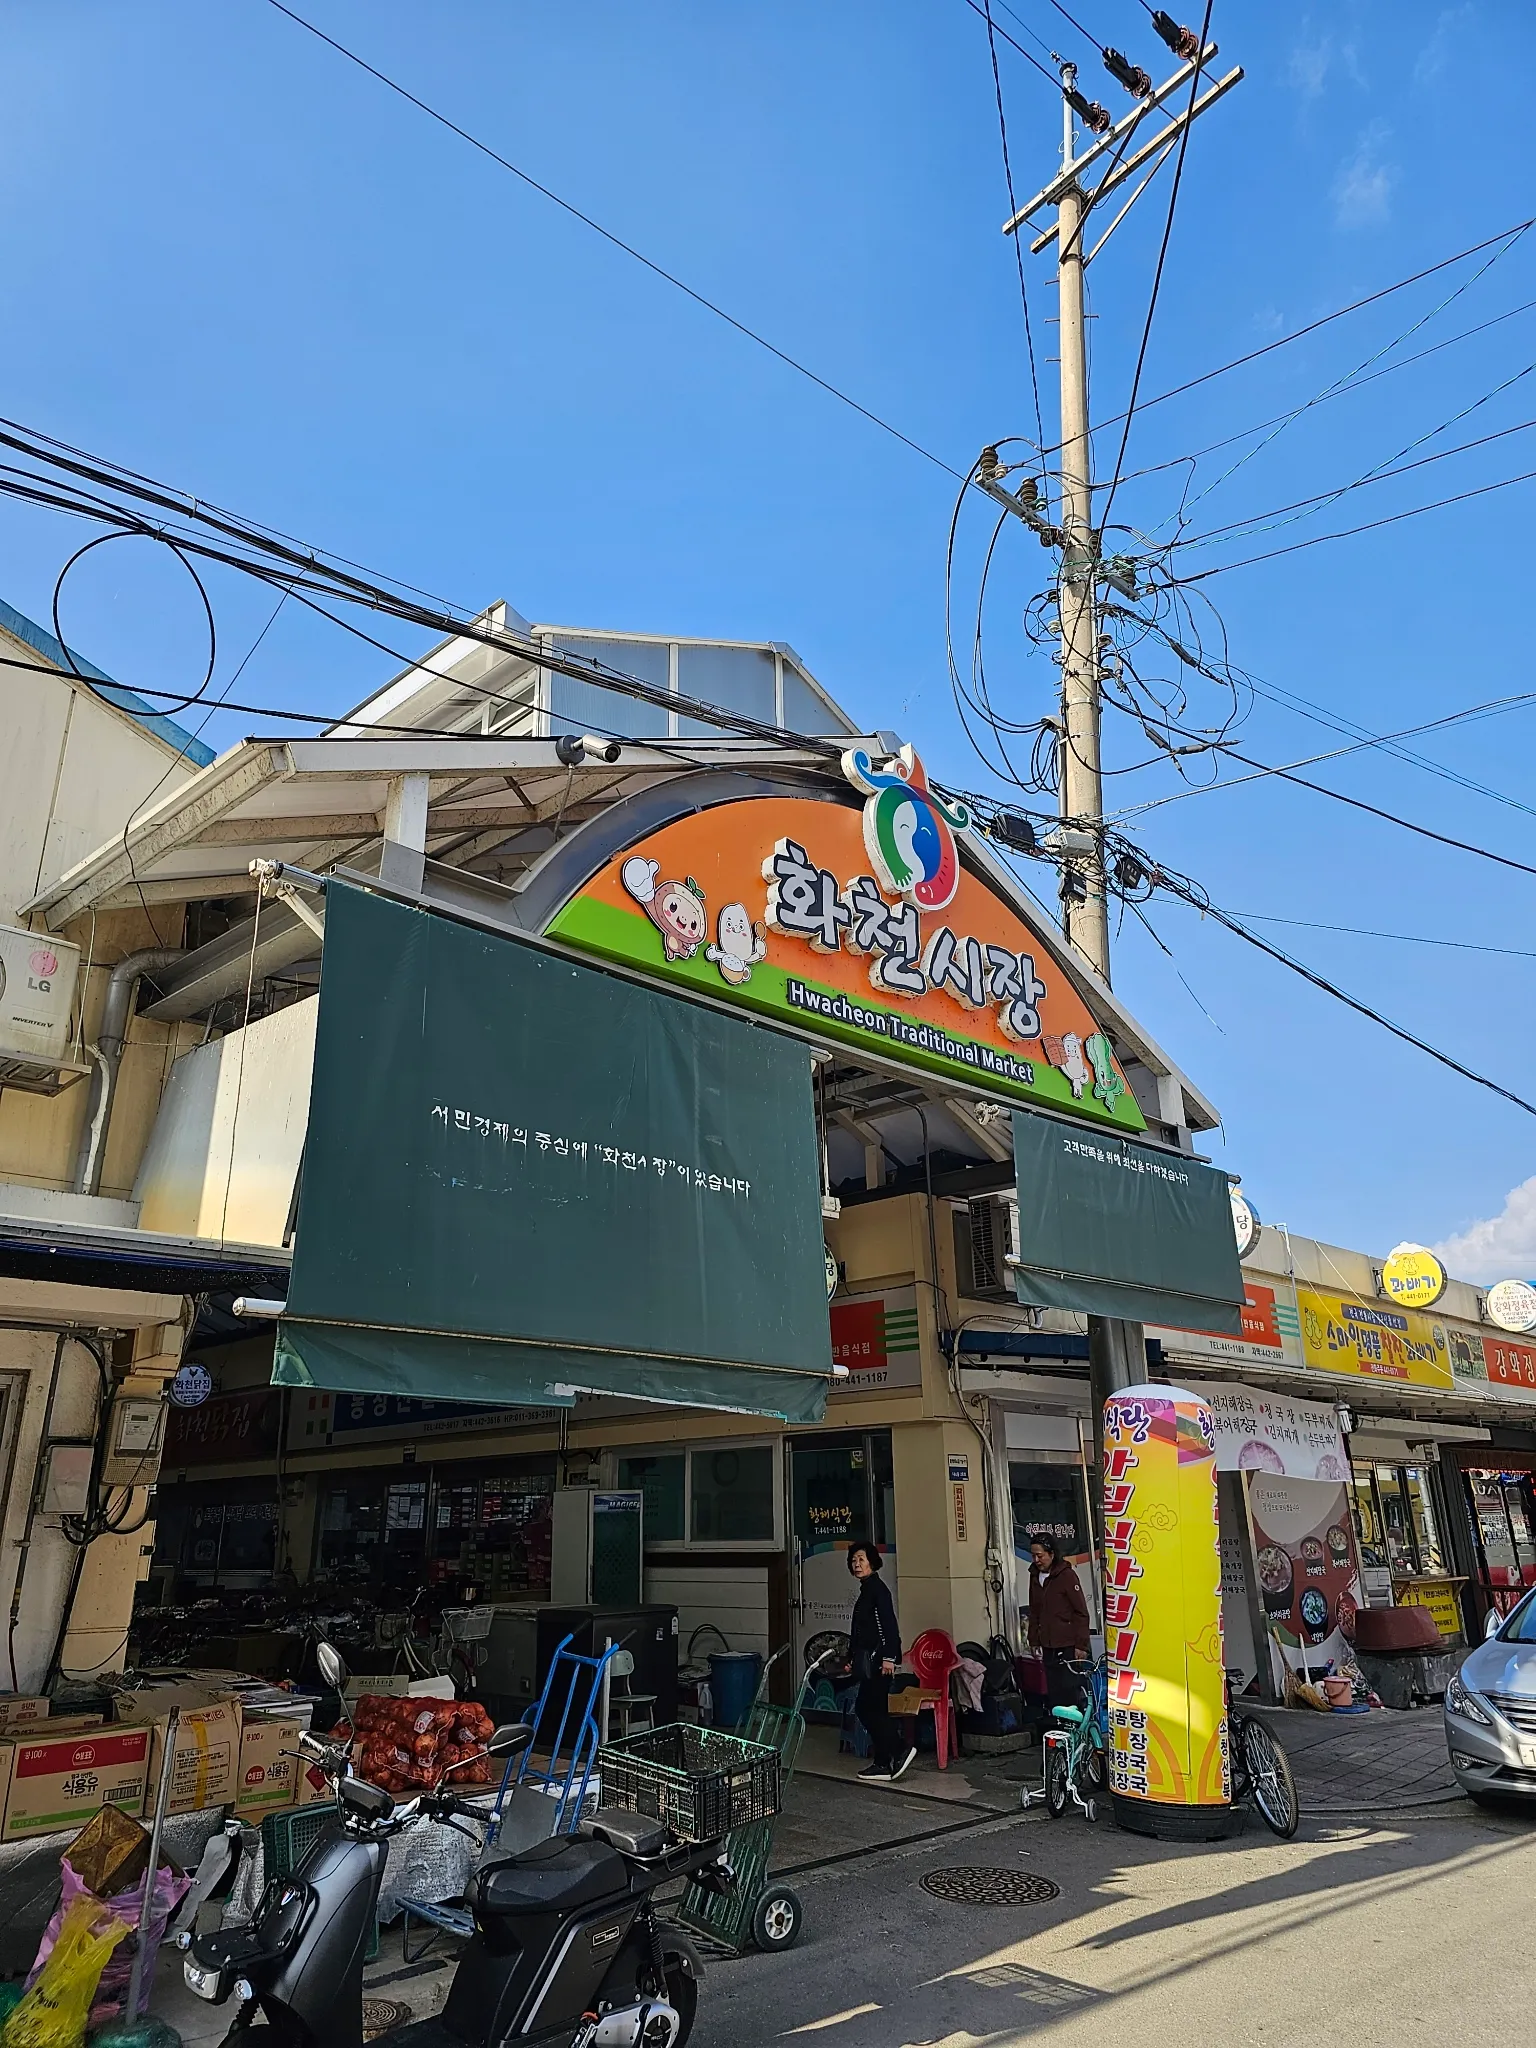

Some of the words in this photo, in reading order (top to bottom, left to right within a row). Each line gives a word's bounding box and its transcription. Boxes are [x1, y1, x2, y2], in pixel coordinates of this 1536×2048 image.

[765, 838, 1047, 1041] 화천시장
[28, 977, 51, 993] LG
[787, 979, 886, 1034] Hwacheon
[889, 1016, 979, 1064] Traditional
[981, 1047, 1034, 1084] Market
[535, 1131, 588, 1161] 중심에
[1063, 1139, 1104, 1162] 고객만족을
[1146, 1162, 1189, 1186] 다하겠습니다
[1390, 1276, 1436, 1293] 꽈배기
[1241, 1319, 1265, 1331] 반음식점
[175, 1379, 210, 1390] 화천닭집
[1212, 1395, 1255, 1414] 선지해장국
[1104, 1403, 1149, 1443] 식당
[1214, 1417, 1258, 1436] 북어해장국
[1268, 1424, 1300, 1445] 김치찌개
[808, 1505, 852, 1523] 황해식당
[75, 1751, 92, 1761] 해표
[247, 1770, 263, 1781] 해표
[267, 1764, 290, 1778] 식용유
[62, 1776, 99, 1796] 식용유
